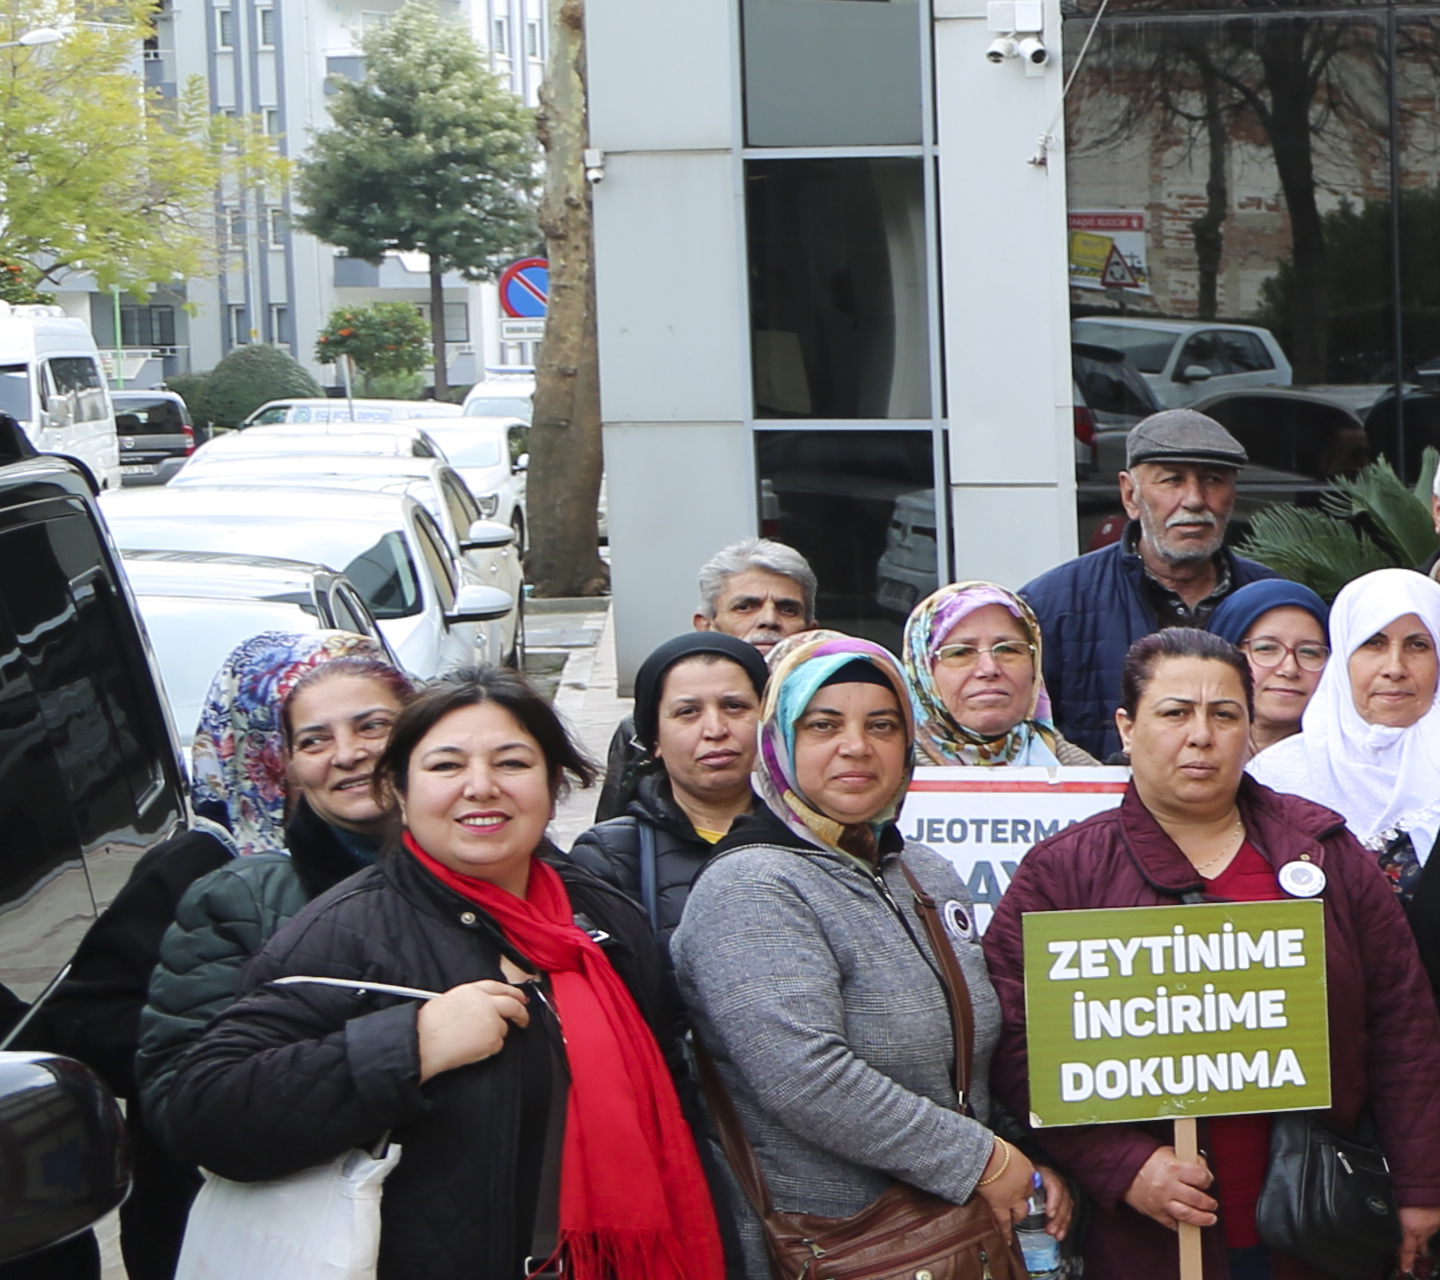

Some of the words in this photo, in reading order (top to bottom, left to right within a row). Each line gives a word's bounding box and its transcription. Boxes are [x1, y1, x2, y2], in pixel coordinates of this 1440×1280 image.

[1047, 921, 1306, 981] ZEYTİNİME
[1072, 983, 1287, 1040] İNCİRİME
[1059, 1048, 1306, 1103] DOKUNMA
